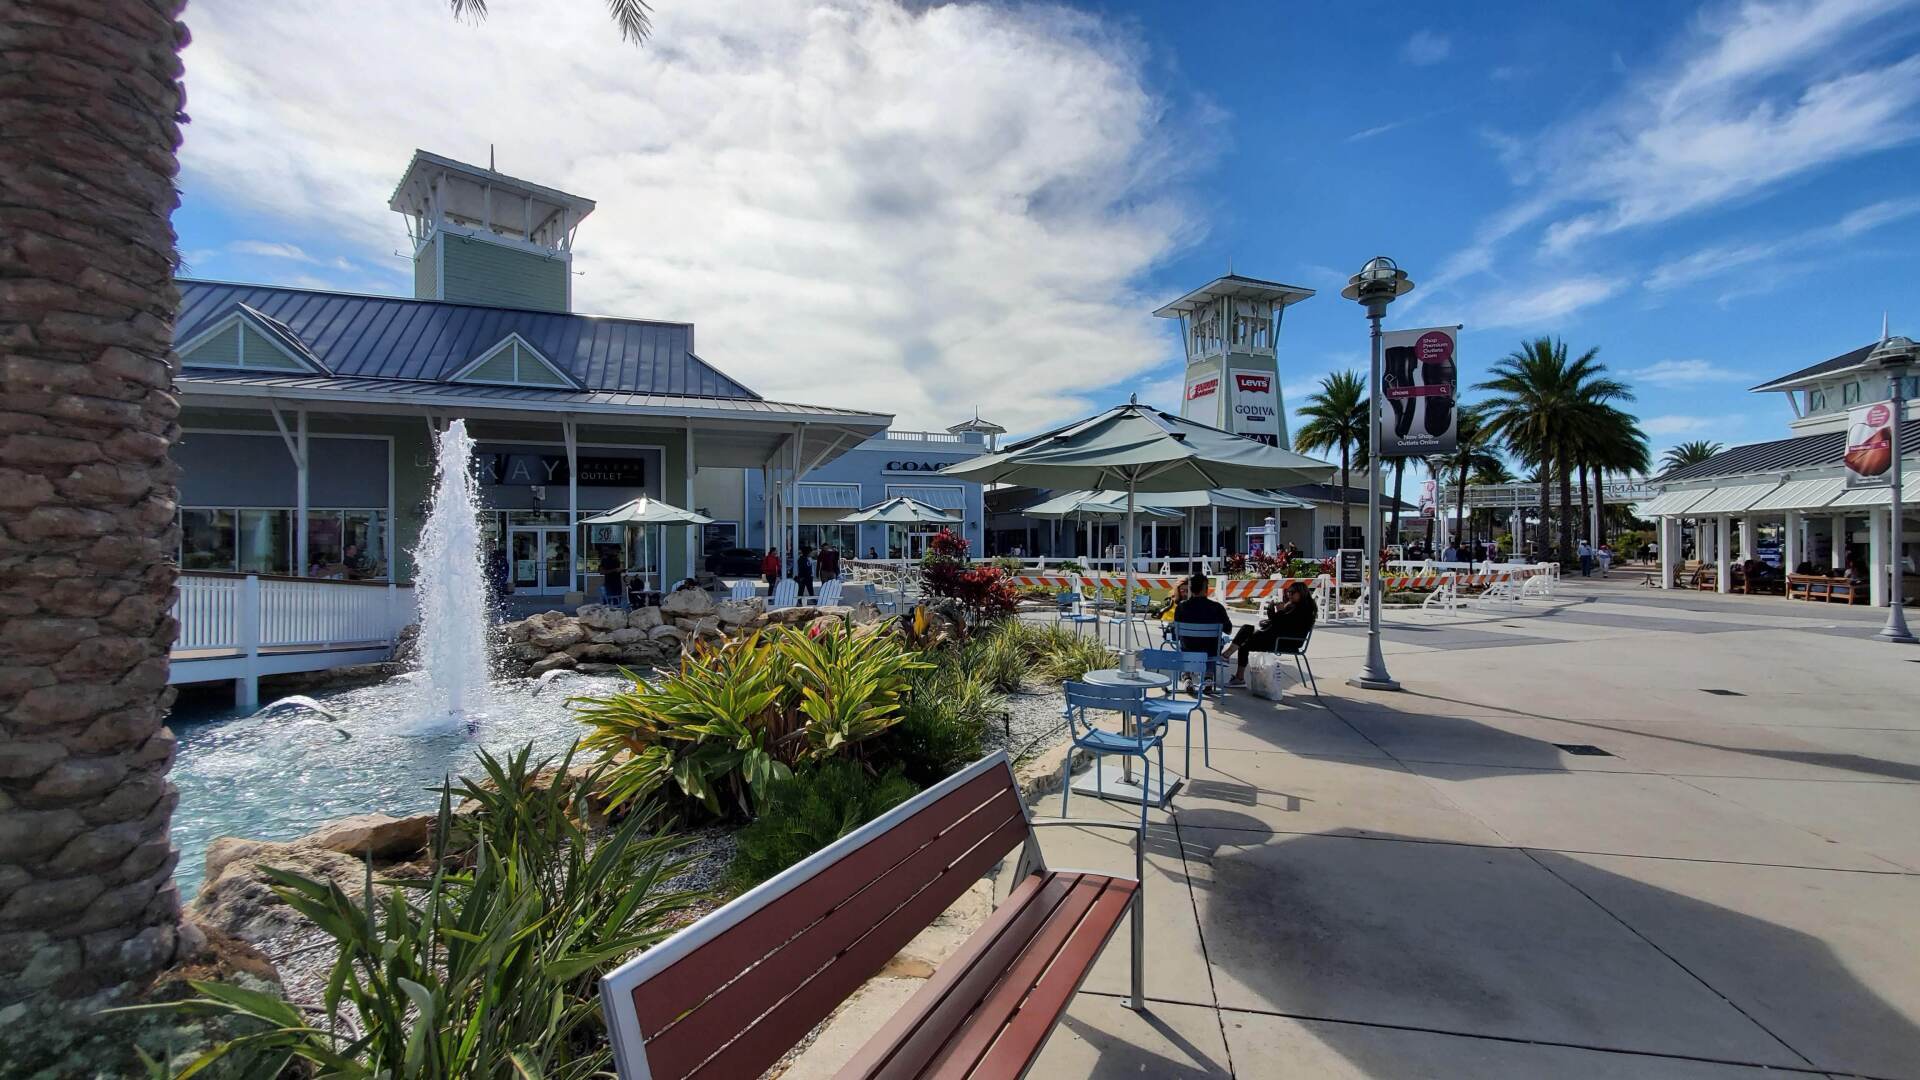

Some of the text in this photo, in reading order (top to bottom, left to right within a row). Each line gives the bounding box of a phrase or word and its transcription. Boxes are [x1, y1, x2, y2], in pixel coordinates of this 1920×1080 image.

[1235, 405, 1275, 416] GODIVA
[480, 458, 560, 481] KAY
[581, 471, 622, 480] OUTLET
